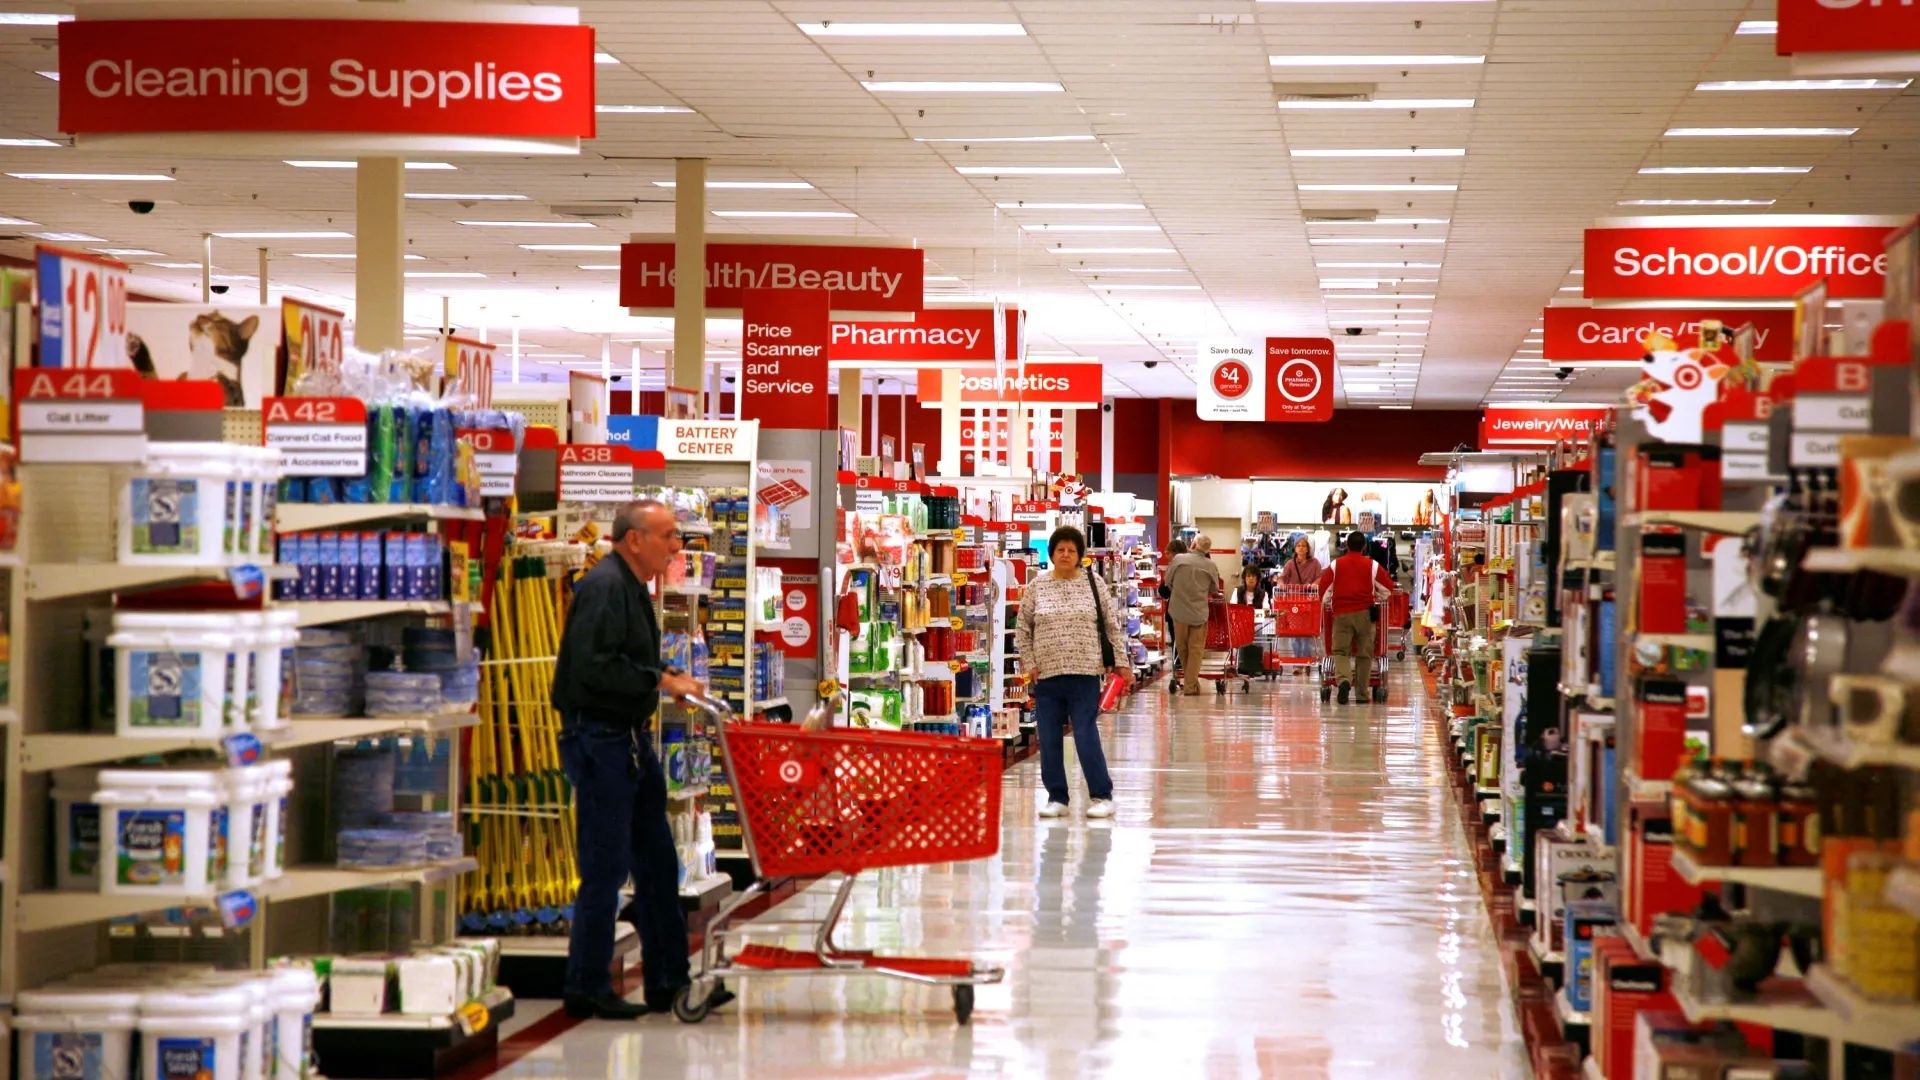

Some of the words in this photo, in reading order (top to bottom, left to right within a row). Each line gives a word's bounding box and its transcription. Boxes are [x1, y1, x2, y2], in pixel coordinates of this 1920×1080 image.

[85, 59, 308, 107] Cleaning
[329, 58, 564, 108] Supplies
[1612, 245, 1889, 277] School/Office
[746, 323, 792, 338] Price
[831, 323, 982, 350] Pharmacy
[746, 342, 822, 357] Scanner
[1210, 346, 1229, 354] Save
[1231, 346, 1254, 356] today.
[1269, 346, 1289, 355] Save
[1291, 346, 1331, 355] tomorrow.
[746, 360, 779, 375] and
[1221, 367, 1239, 384] $4
[29, 373, 57, 398] A
[63, 373, 114, 398] 44
[746, 379, 814, 394] Service
[46, 412, 71, 424] Cat
[75, 411, 111, 424] Litter
[266, 402, 290, 422] A
[294, 402, 336, 422] 42
[266, 432, 309, 443] Canned
[312, 432, 331, 443] Cat
[334, 432, 363, 443] Food
[676, 426, 738, 439] BATTERY
[562, 447, 578, 462] A
[582, 447, 612, 462] 38
[677, 442, 733, 455] CENTER
[291, 457, 359, 468] Accessories
[598, 470, 632, 478] Cleaners
[598, 487, 632, 496] Cleaners
[1014, 504, 1023, 512] A
[1025, 504, 1036, 512] 18
